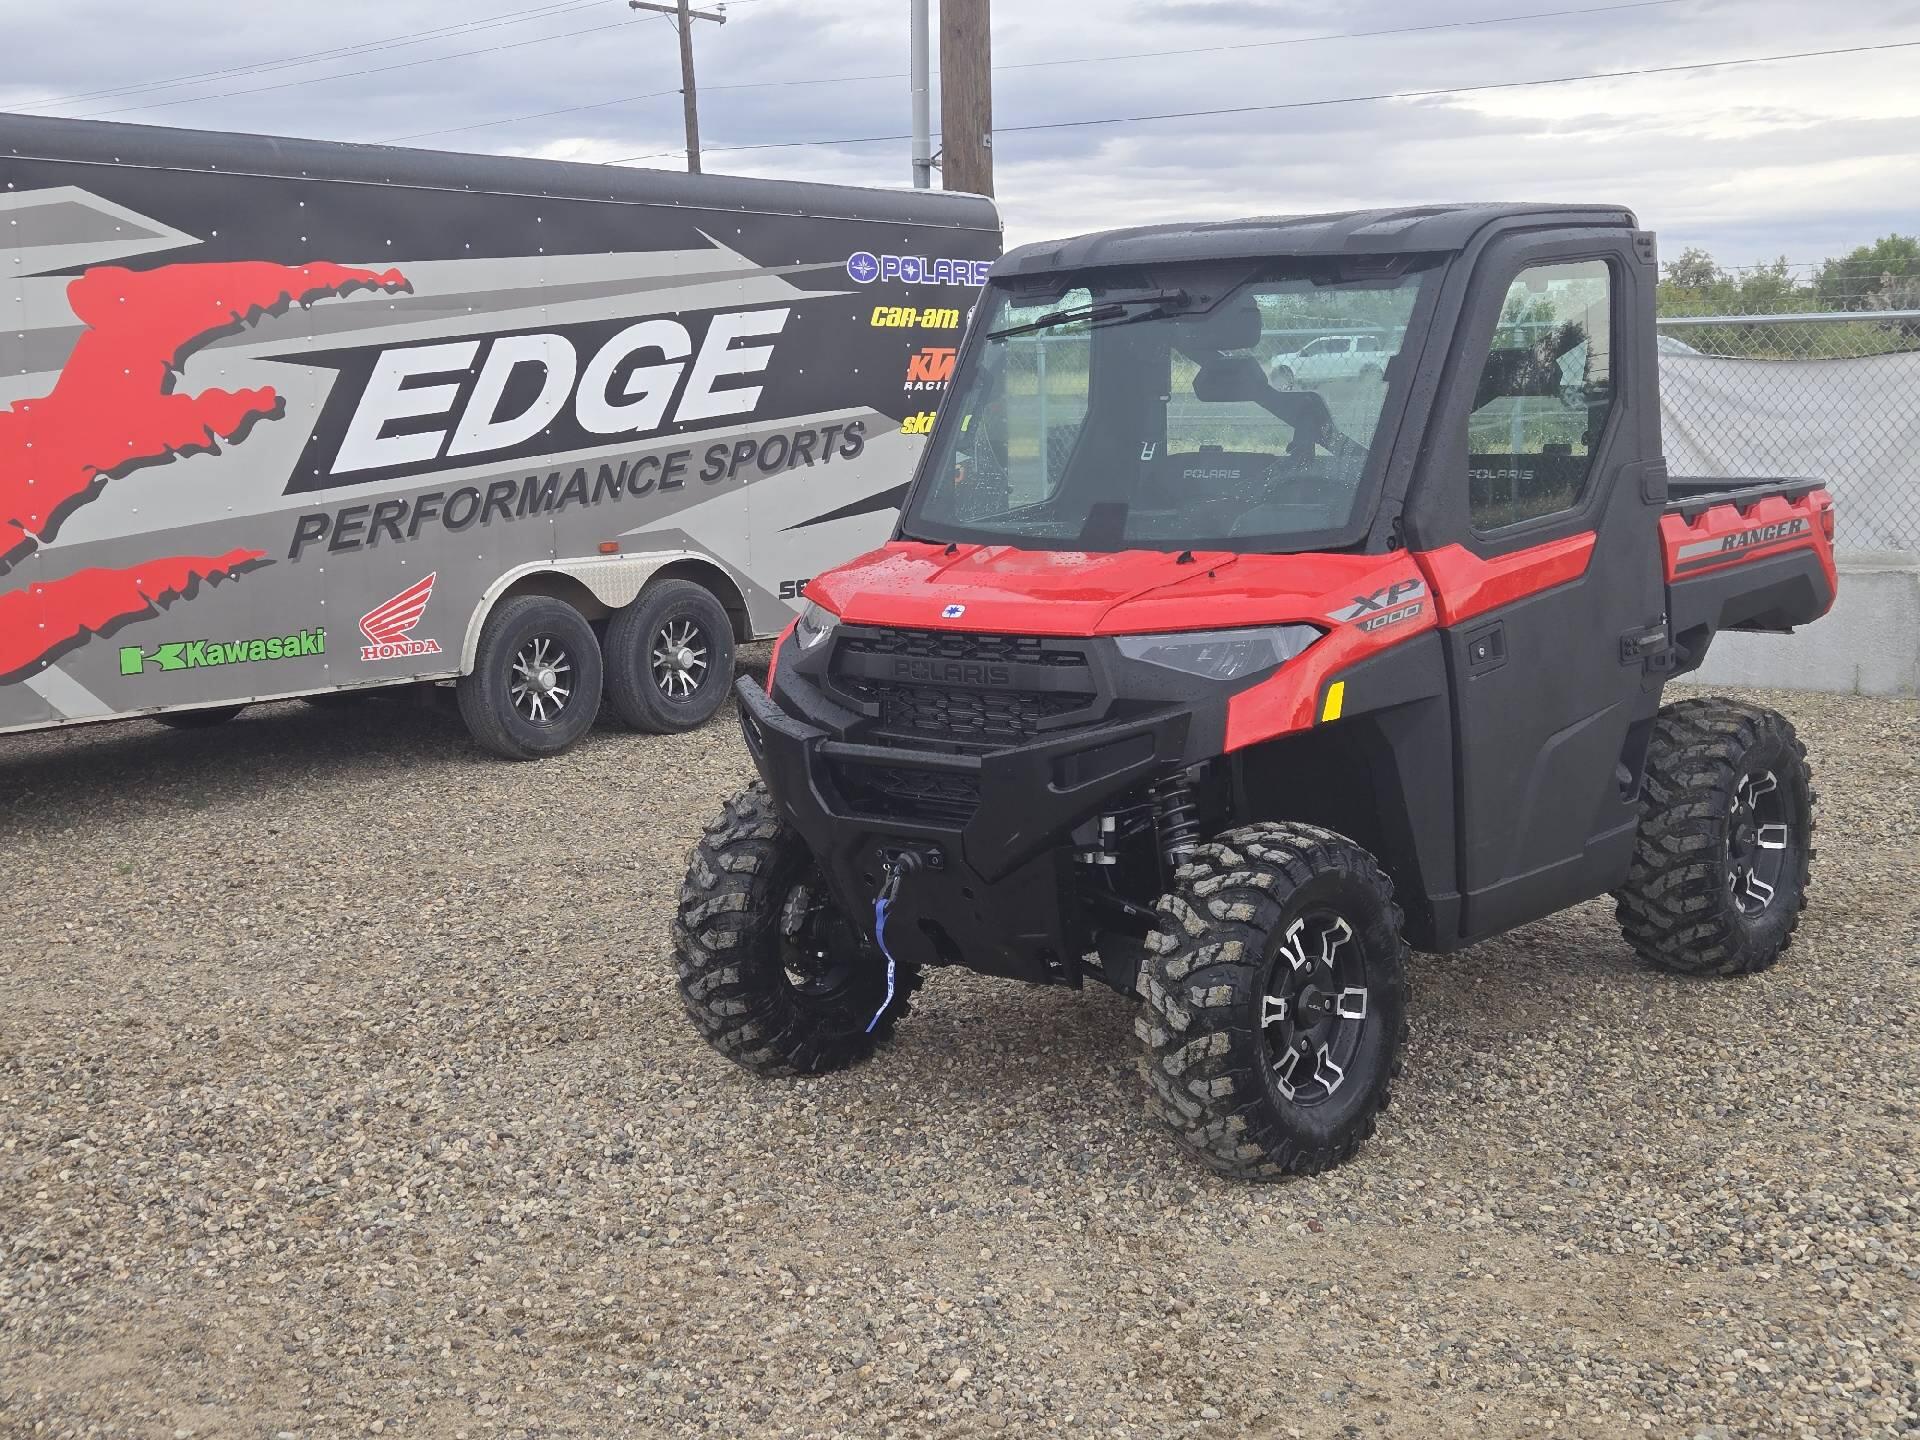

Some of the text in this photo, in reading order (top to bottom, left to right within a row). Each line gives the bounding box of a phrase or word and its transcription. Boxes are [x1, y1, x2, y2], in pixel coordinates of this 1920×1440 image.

[881, 255, 995, 286] POLARIS
[329, 308, 791, 475] EDGE
[1183, 469, 1241, 479] POLARIS
[286, 420, 866, 562] PERFORMANCE SPORTS
[1720, 518, 1803, 552] RANGER
[1343, 578, 1421, 620] XP
[1365, 604, 1420, 632] 1000
[184, 627, 325, 671] Kawasaki
[360, 638, 443, 662] HONDA
[894, 659, 1010, 685] POLARIS
